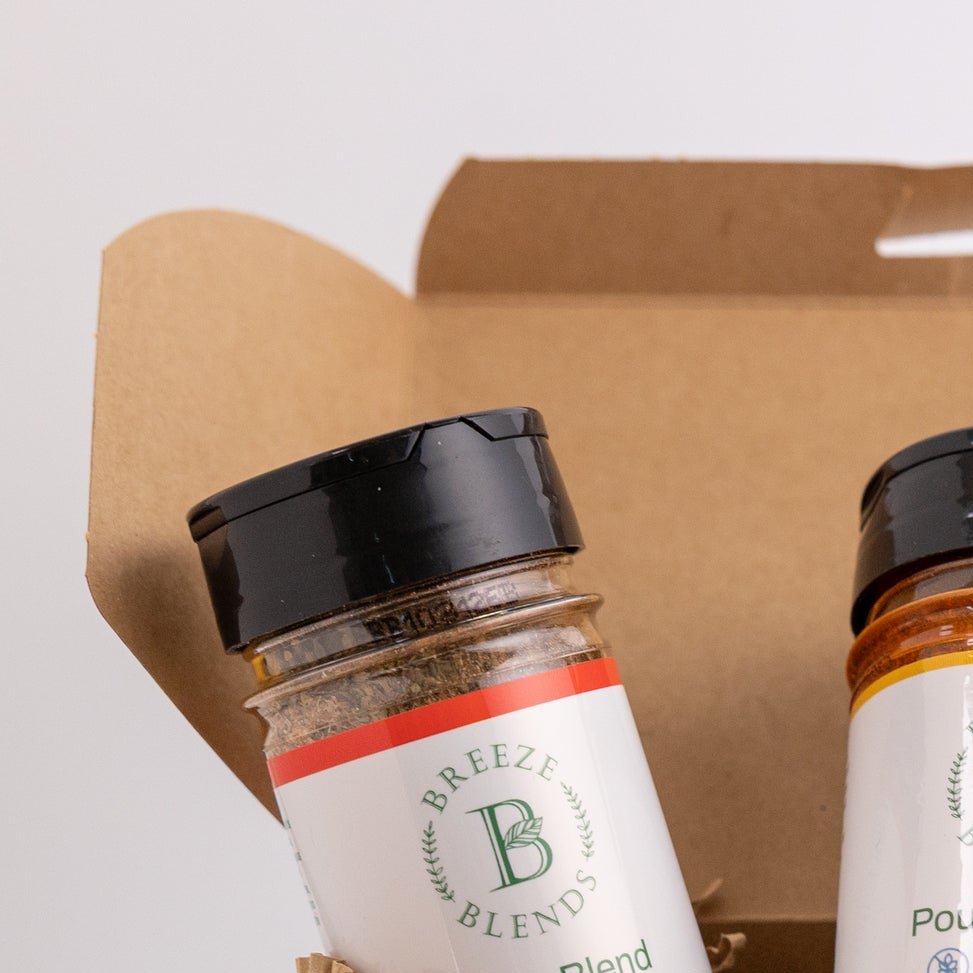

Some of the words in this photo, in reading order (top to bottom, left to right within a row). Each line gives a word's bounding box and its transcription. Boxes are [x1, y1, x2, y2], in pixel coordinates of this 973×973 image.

[420, 743, 560, 813] BREEZE
[465, 798, 555, 893] B
[457, 869, 598, 940] BLENDS
